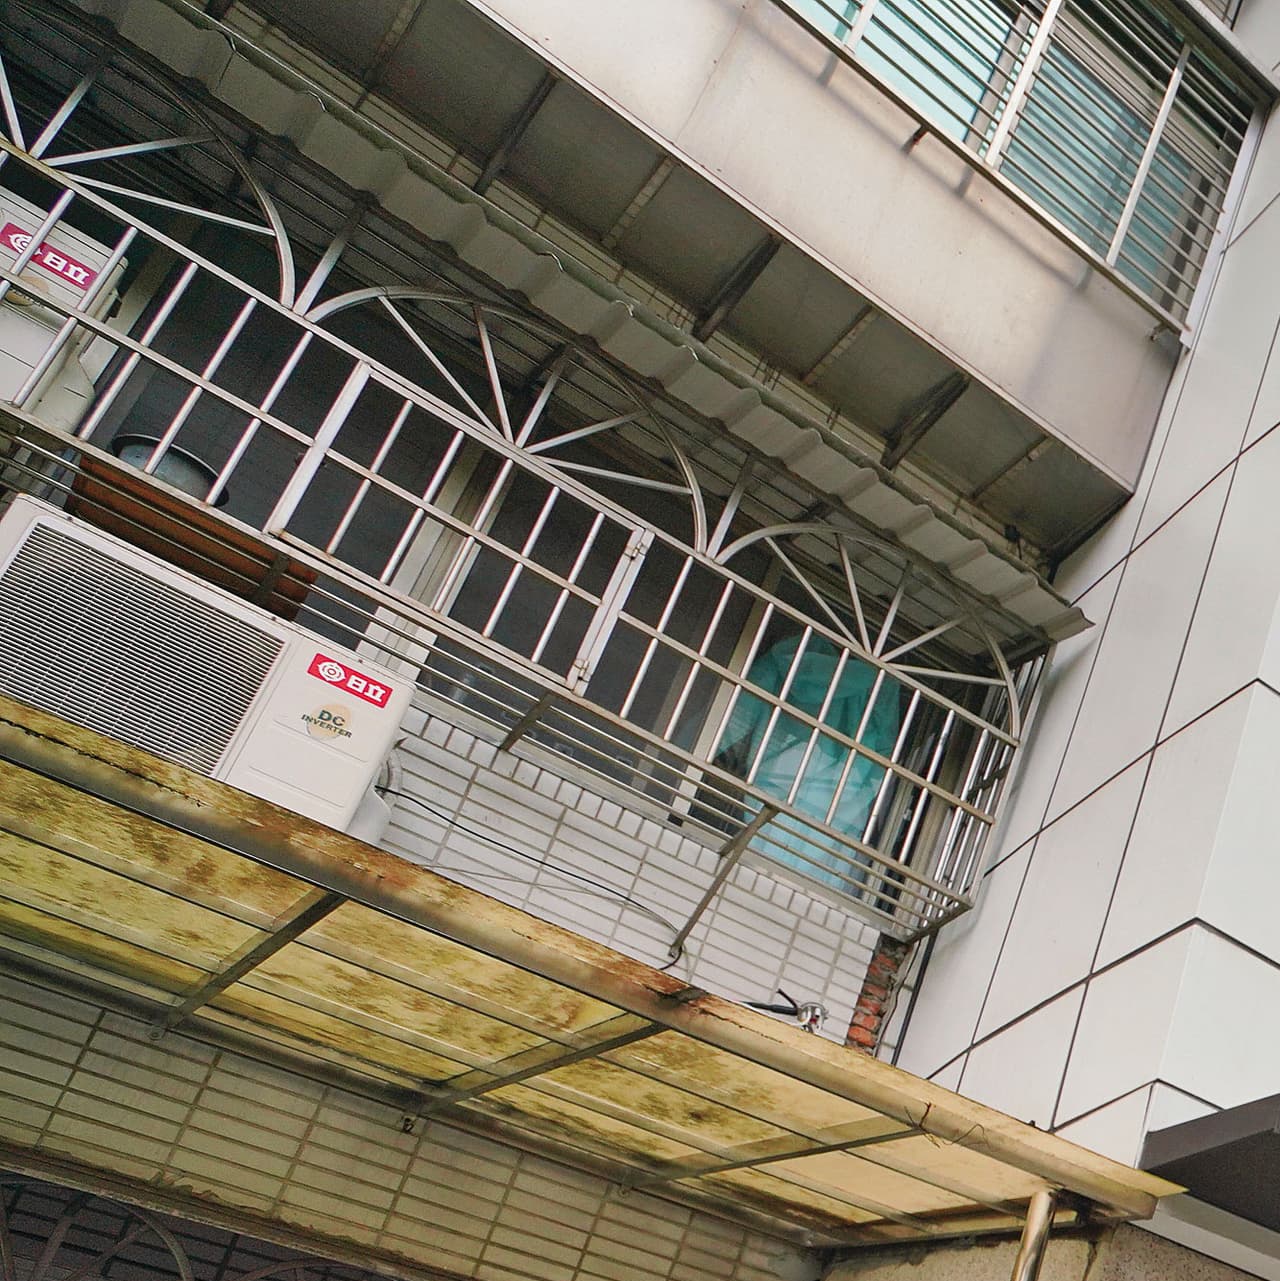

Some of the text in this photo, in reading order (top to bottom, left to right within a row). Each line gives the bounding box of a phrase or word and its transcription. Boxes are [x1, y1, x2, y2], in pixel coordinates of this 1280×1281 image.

[346, 674, 386, 703] 日立
[301, 714, 353, 738] INVERTER
[317, 709, 346, 727] DC
